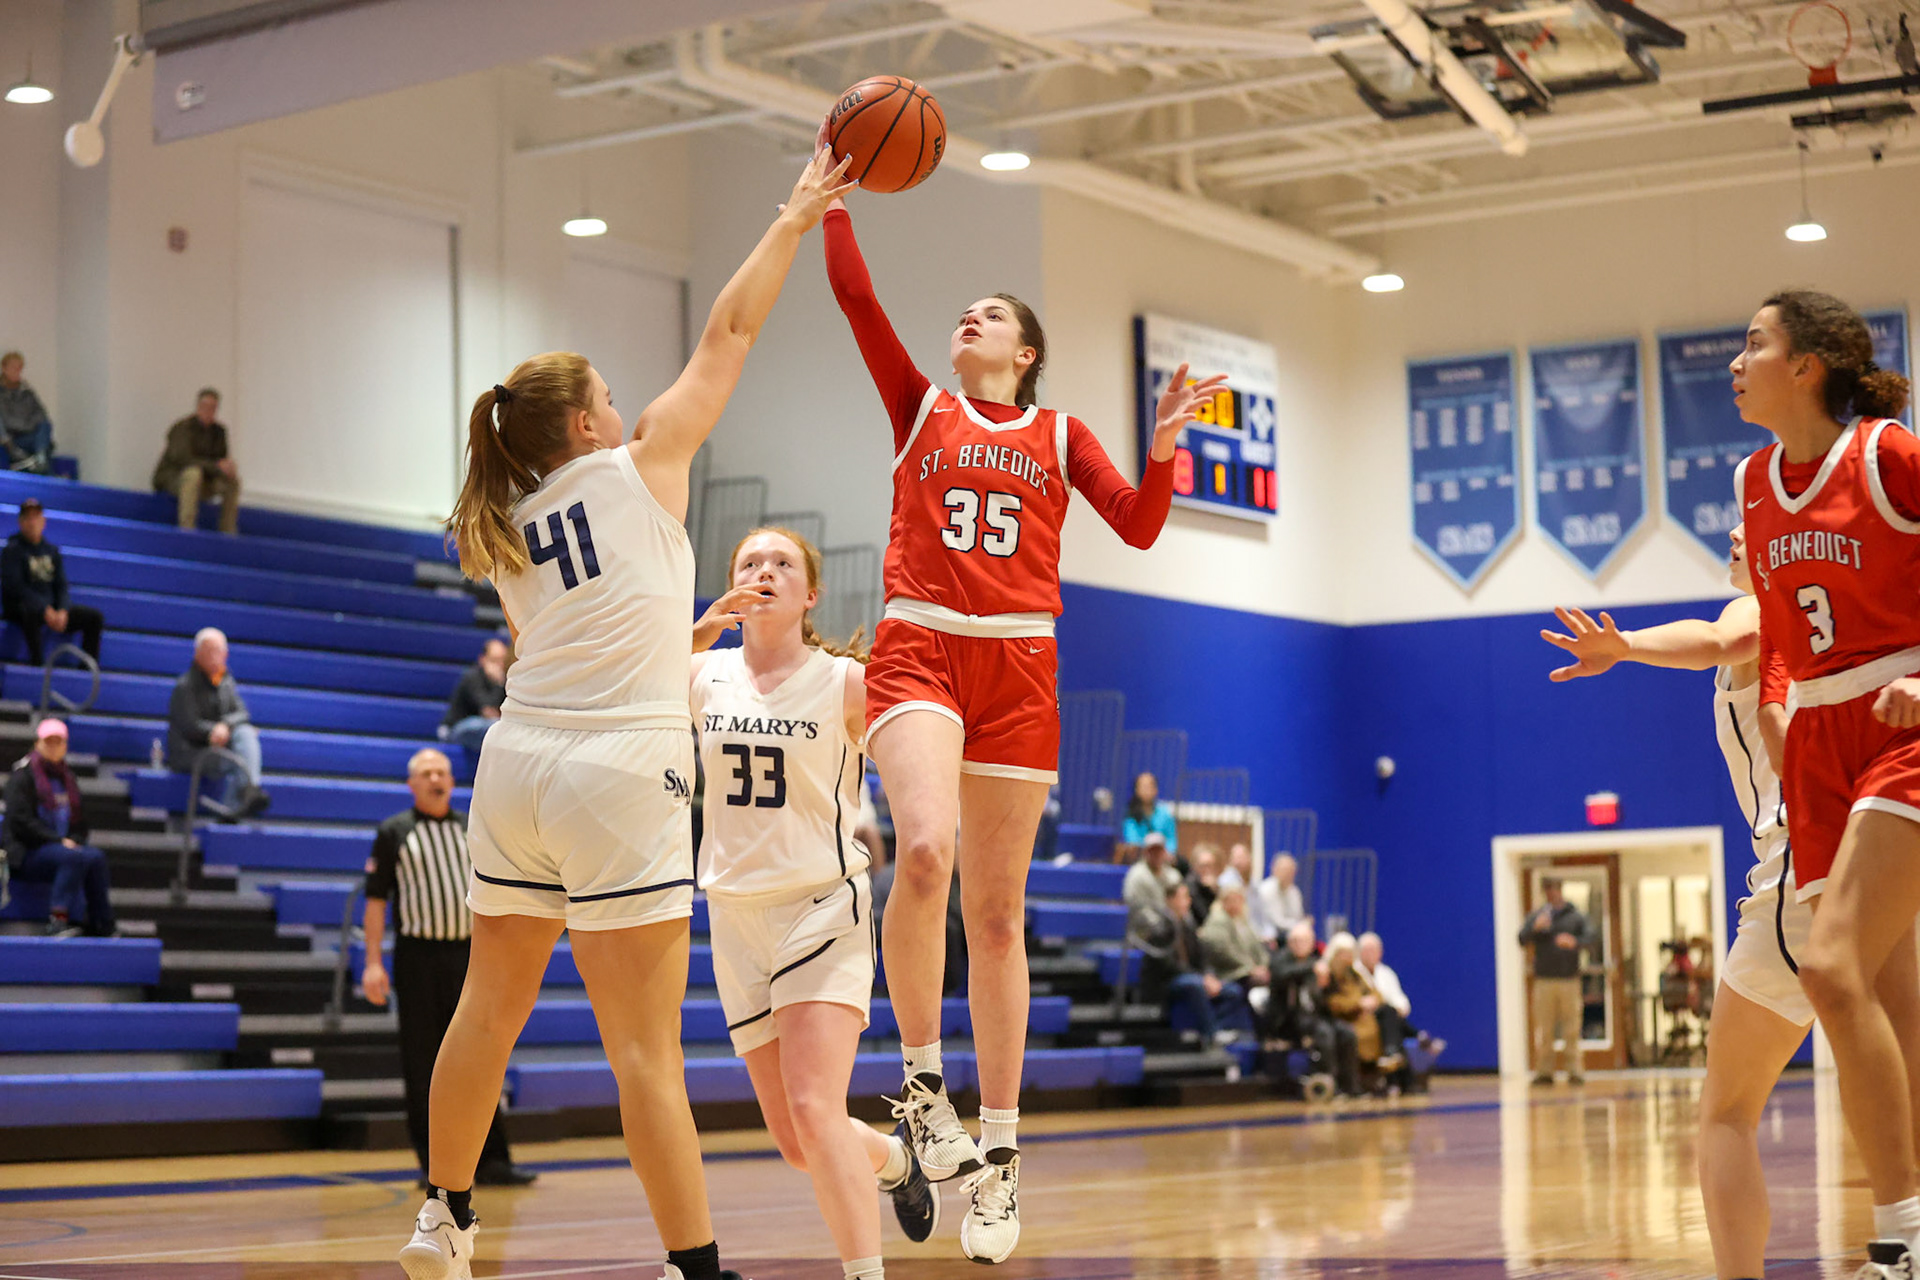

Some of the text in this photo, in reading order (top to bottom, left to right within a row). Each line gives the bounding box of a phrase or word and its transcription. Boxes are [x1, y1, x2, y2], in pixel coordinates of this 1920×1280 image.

[919, 443, 1050, 497] ST. BENEDICT
[523, 500, 602, 591] 41
[940, 486, 1023, 559] 35
[1767, 530, 1863, 571] BENEDICT
[1795, 583, 1836, 656] 3
[727, 715, 819, 740] MARY'S
[722, 743, 787, 809] 33
